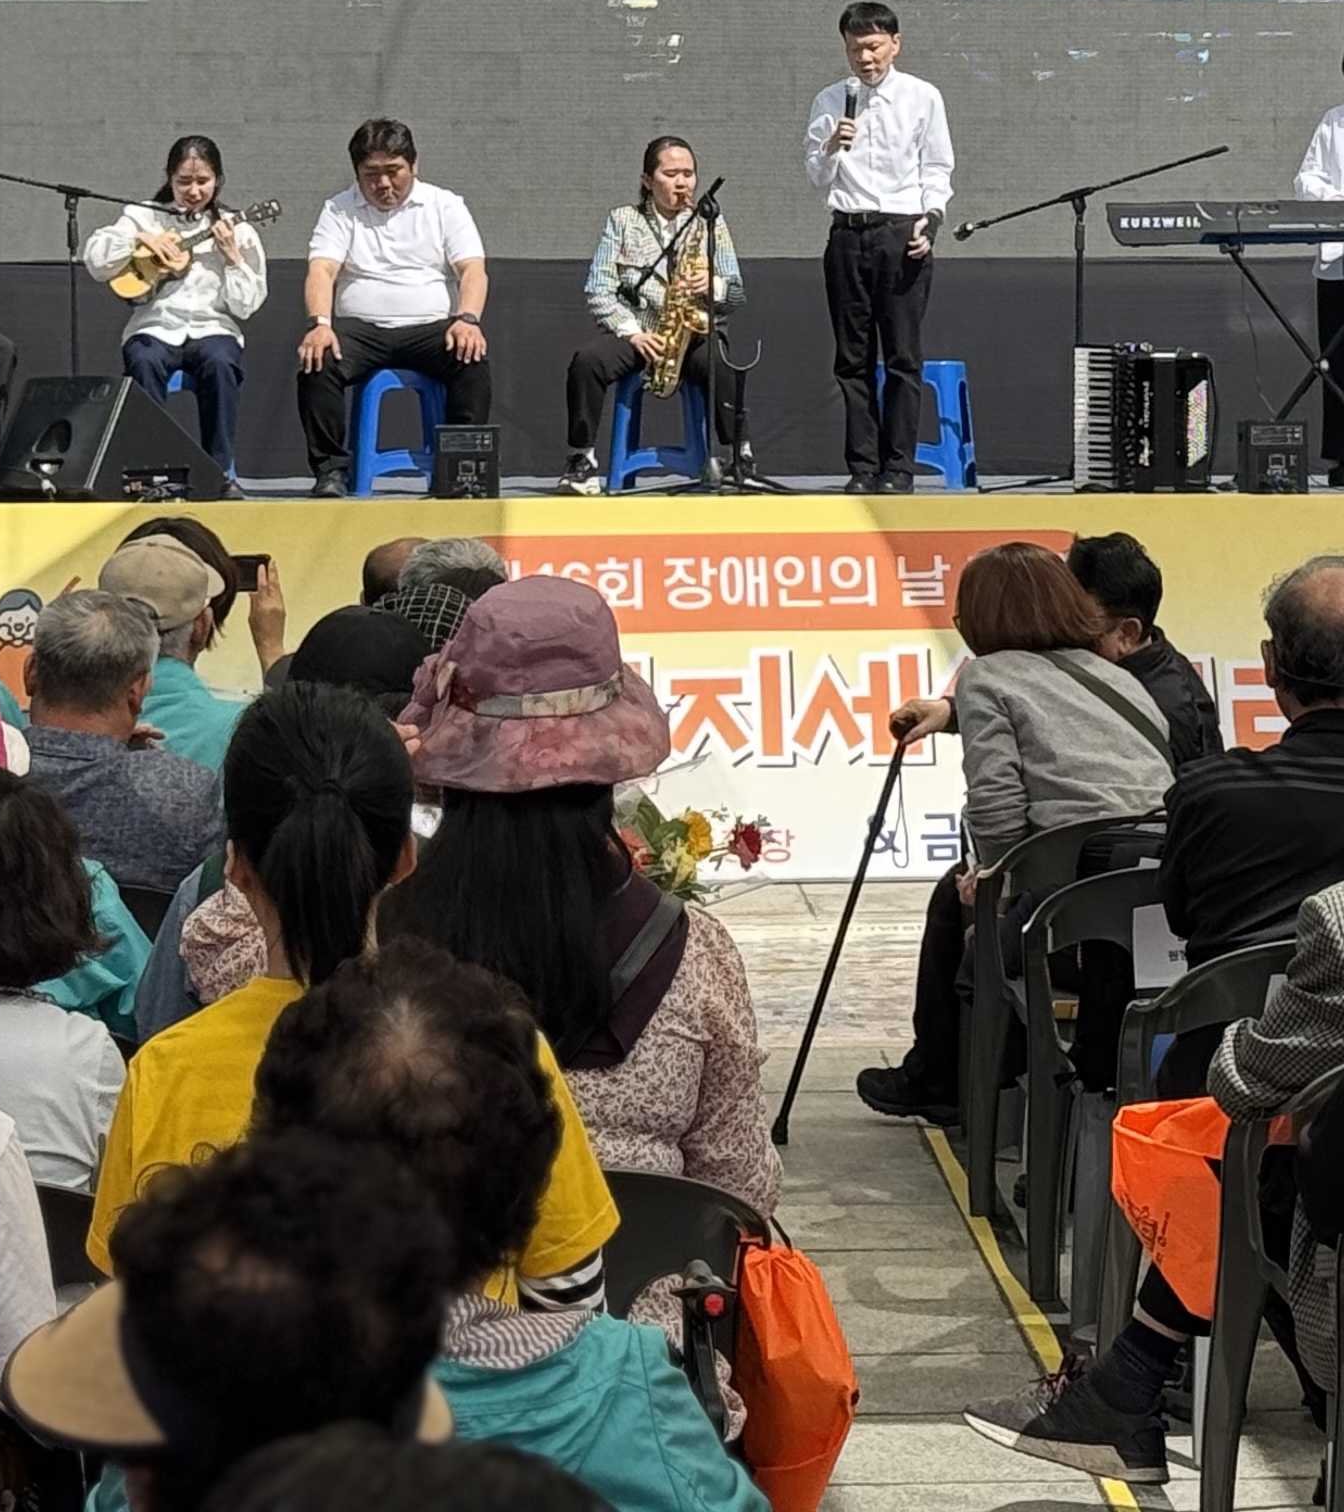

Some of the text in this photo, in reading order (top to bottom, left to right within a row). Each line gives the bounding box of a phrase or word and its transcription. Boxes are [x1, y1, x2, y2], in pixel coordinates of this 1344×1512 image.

[1120, 216, 1202, 229] KURZWEIL
[663, 555, 879, 610] 장애인의
[897, 555, 952, 607] 날
[631, 653, 956, 758] 지세
